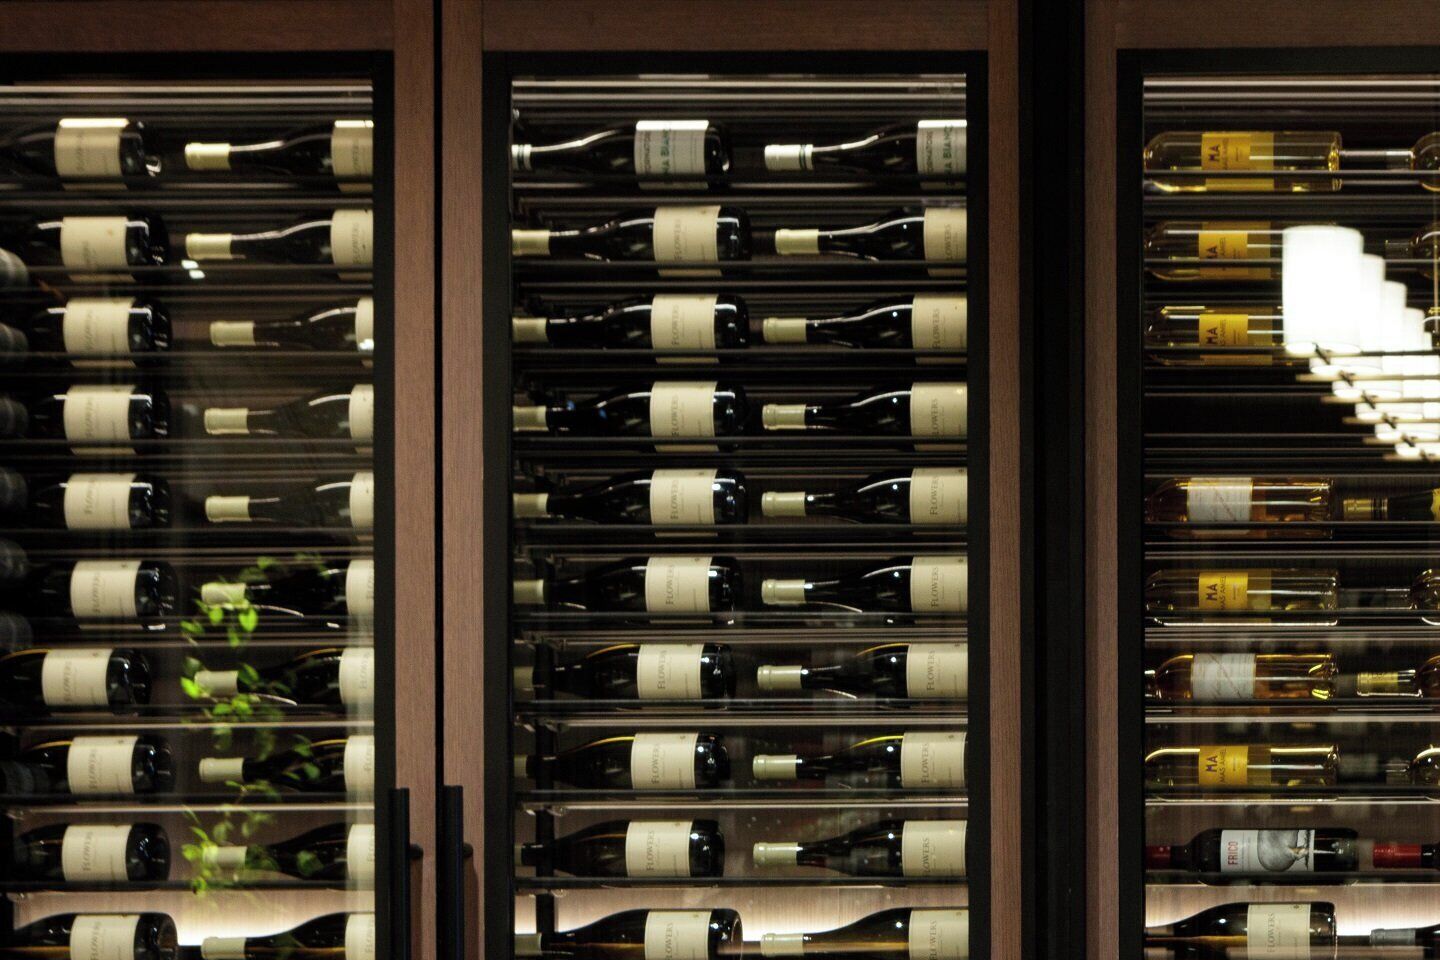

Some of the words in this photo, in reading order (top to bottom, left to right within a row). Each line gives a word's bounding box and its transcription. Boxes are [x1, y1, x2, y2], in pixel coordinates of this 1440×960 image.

[1207, 144, 1220, 162] MA
[1205, 327, 1218, 345] MA
[670, 478, 680, 521] FLOWERS
[929, 476, 940, 517] FLOWERS
[665, 563, 675, 606] FLOWERS
[930, 566, 940, 609] FLOWERS
[1205, 583, 1218, 601] MA
[656, 648, 667, 691] FLOWERS
[926, 648, 936, 691] FLOWERS
[650, 742, 660, 785] FLOWERS
[920, 742, 930, 784] FLOWERS
[1205, 755, 1218, 773] MA
[645, 829, 655, 872] FLOWERS
[920, 835, 931, 874] LOWERS
[1227, 841, 1239, 865] FRICO
[928, 919, 939, 960] FLOWERS
[1266, 912, 1276, 954] FLOWERS
